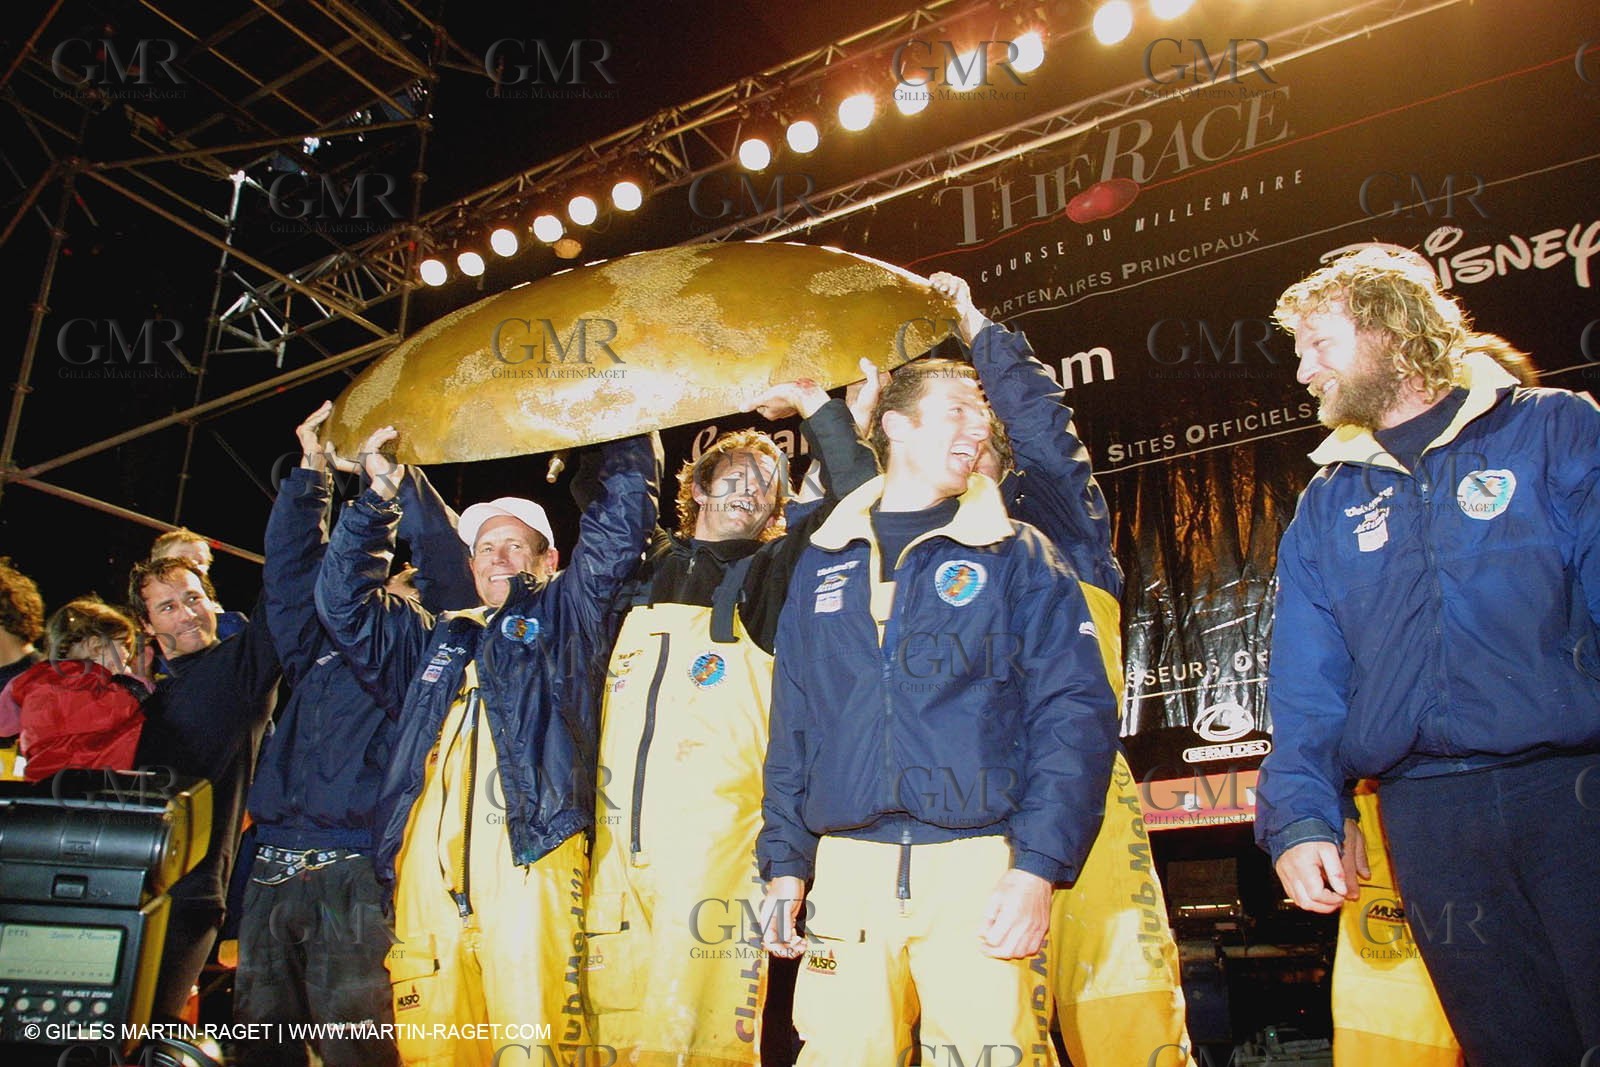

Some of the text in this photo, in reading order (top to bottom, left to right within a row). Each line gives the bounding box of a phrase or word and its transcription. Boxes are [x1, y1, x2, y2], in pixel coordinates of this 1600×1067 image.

[938, 85, 1290, 247] THE RACE
[980, 169, 1304, 283] COURSE DU MILLENAIRE
[1121, 228, 1261, 280] PRINCIPAUX
[1107, 402, 1312, 463] SITES OFFICIELS
[1130, 884, 1164, 970] Club
